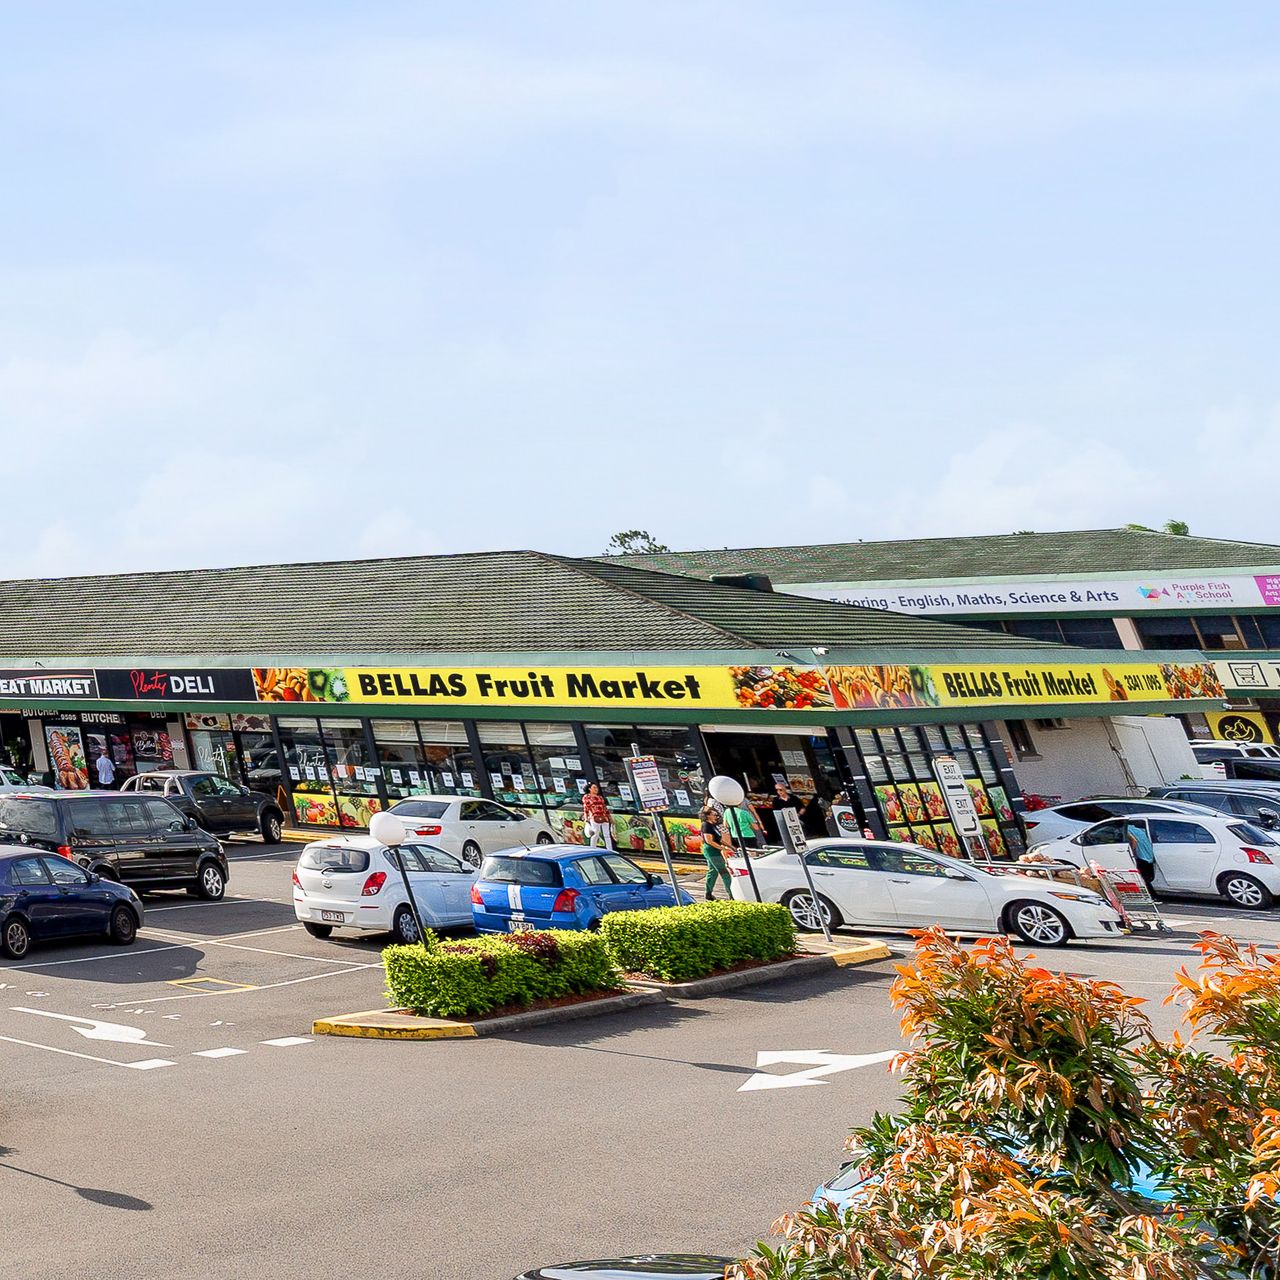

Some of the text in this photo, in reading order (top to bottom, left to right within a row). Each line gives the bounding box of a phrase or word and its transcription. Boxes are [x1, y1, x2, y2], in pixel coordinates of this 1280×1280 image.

[1172, 582, 1230, 591] Purple Fish
[1196, 591, 1232, 599] School
[899, 595, 955, 609] English,
[957, 592, 1007, 607] Maths,
[1010, 590, 1067, 604] Science
[1070, 590, 1083, 602] &
[1086, 589, 1120, 602] Arts
[29, 679, 91, 694] MARKET
[130, 670, 215, 698] Plenty DELI
[357, 671, 702, 700] BELLAS Fruit Market
[943, 670, 1162, 697] BELLAS Fruit Market 3341 1095
[81, 713, 125, 724] BUTCHE
